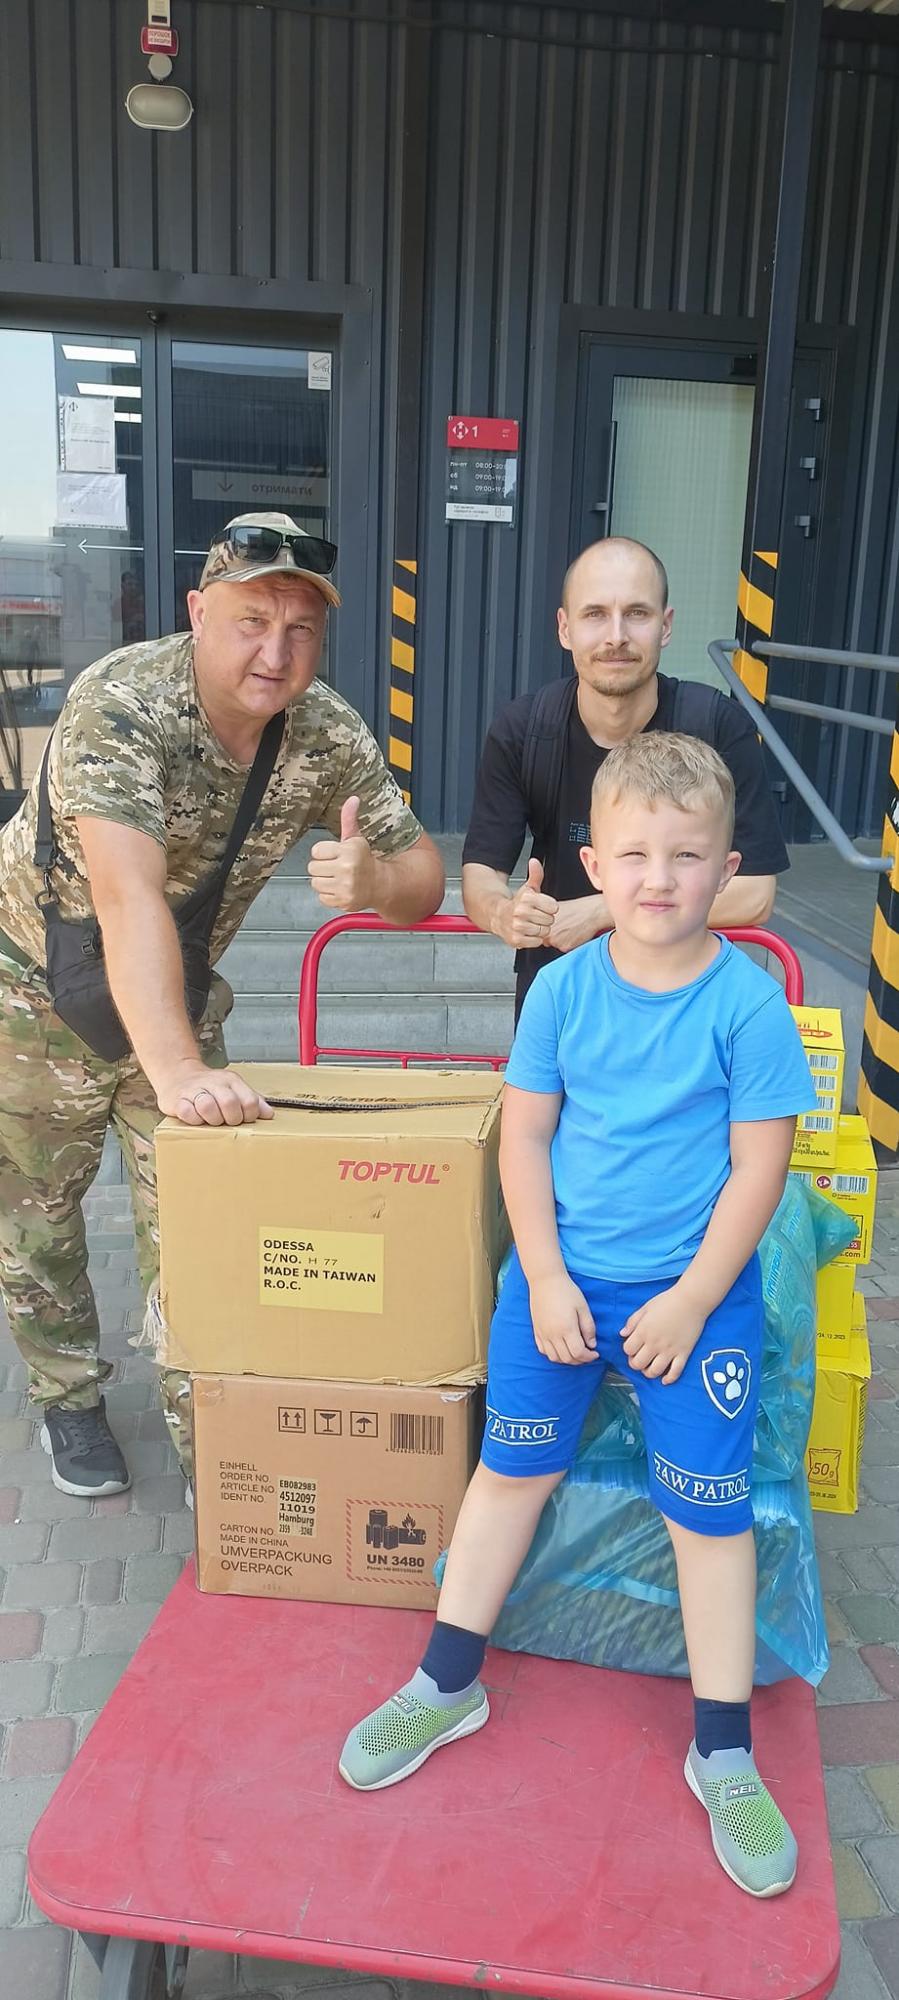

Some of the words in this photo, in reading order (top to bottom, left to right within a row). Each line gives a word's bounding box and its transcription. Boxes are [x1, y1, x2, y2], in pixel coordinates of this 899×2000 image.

[471, 425, 479, 438] 1
[475, 462, 506, 470] 08:00-20:
[251, 483, 313, 496] отримати
[474, 484, 506, 493] 09:00-19:0
[263, 1239, 314, 1252] ODESSA
[263, 1252, 302, 1264] C/NO.
[308, 1257, 317, 1265] H
[324, 1258, 338, 1266] 77
[264, 1266, 299, 1277] MADE
[303, 1268, 318, 1279] IN
[323, 1270, 376, 1283] TAIWAN
[264, 1278, 301, 1291] R.O.C.
[491, 1418, 558, 1439] PATROL
[219, 1461, 257, 1471] EINHELL
[219, 1471, 253, 1482] ORDER
[220, 1482, 259, 1492] ARTICLE
[280, 1479, 317, 1491] EB082983
[692, 1476, 750, 1499] PATROL
[220, 1492, 248, 1502] IDENT
[280, 1491, 317, 1504] 4512097
[280, 1502, 316, 1514] 11019
[278, 1512, 315, 1527] Hamburg
[219, 1523, 258, 1534] CARTON
[219, 1534, 246, 1544] MADE
[260, 1537, 289, 1548] CHINA
[220, 1545, 333, 1565] UMVERPACKUNG
[367, 1554, 388, 1565] UN
[391, 1555, 425, 1568] 3480
[221, 1560, 293, 1577] OVERPACK
